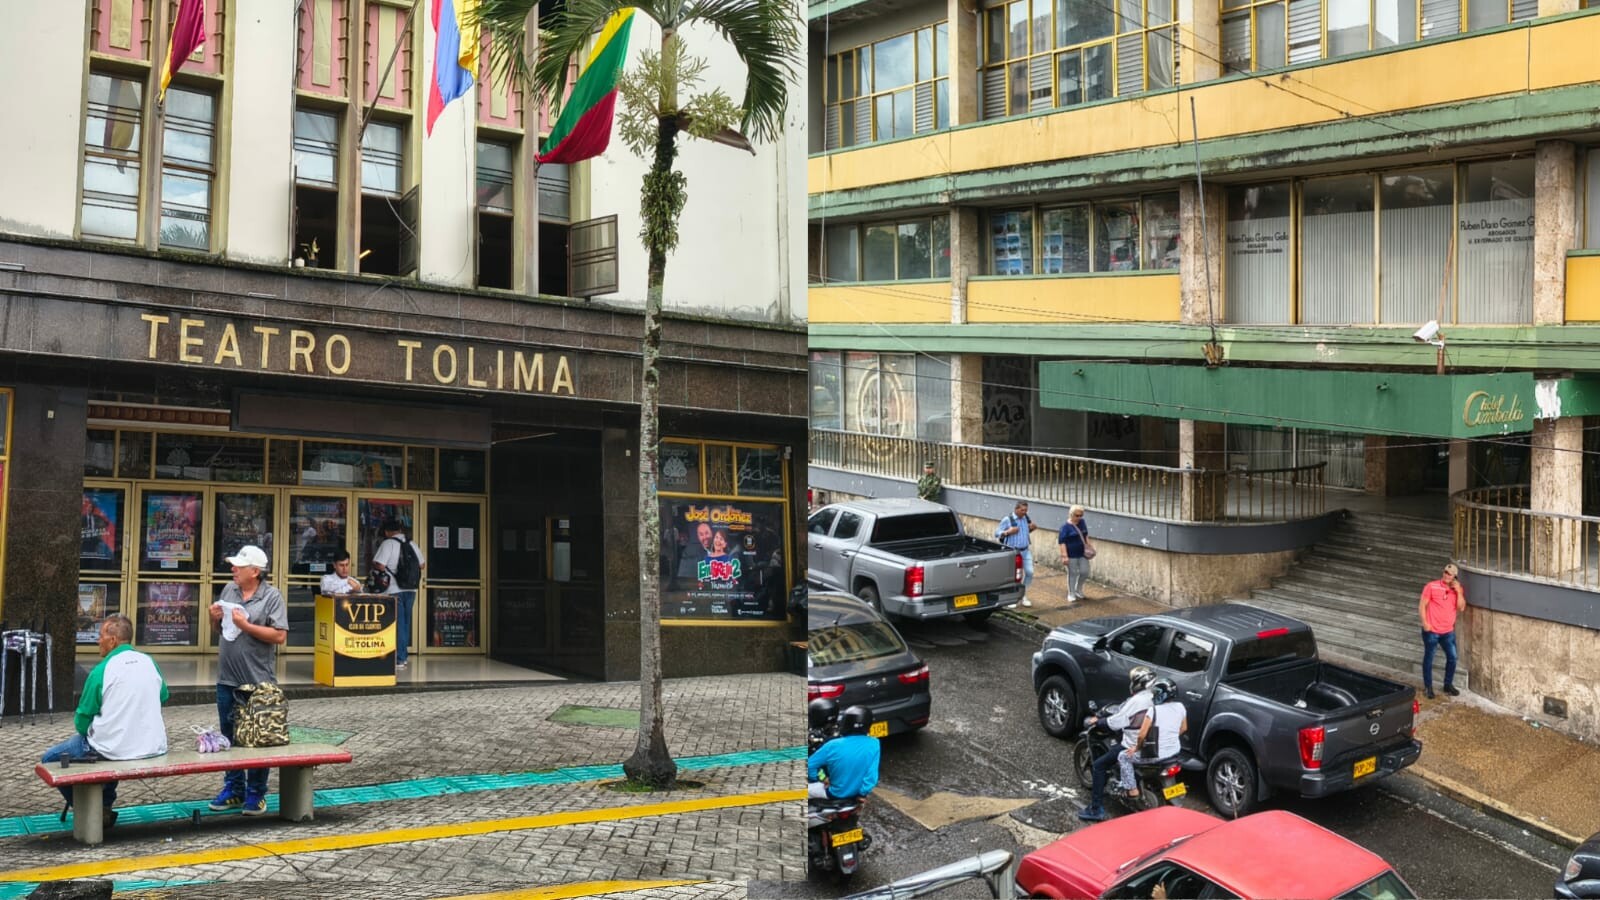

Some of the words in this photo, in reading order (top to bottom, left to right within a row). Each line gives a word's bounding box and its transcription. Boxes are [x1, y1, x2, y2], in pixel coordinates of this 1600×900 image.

[140, 313, 352, 376] TEATRO
[397, 339, 575, 395] TOLIMA
[147, 614, 188, 624] PLANCHA
[346, 603, 386, 623] VIP
